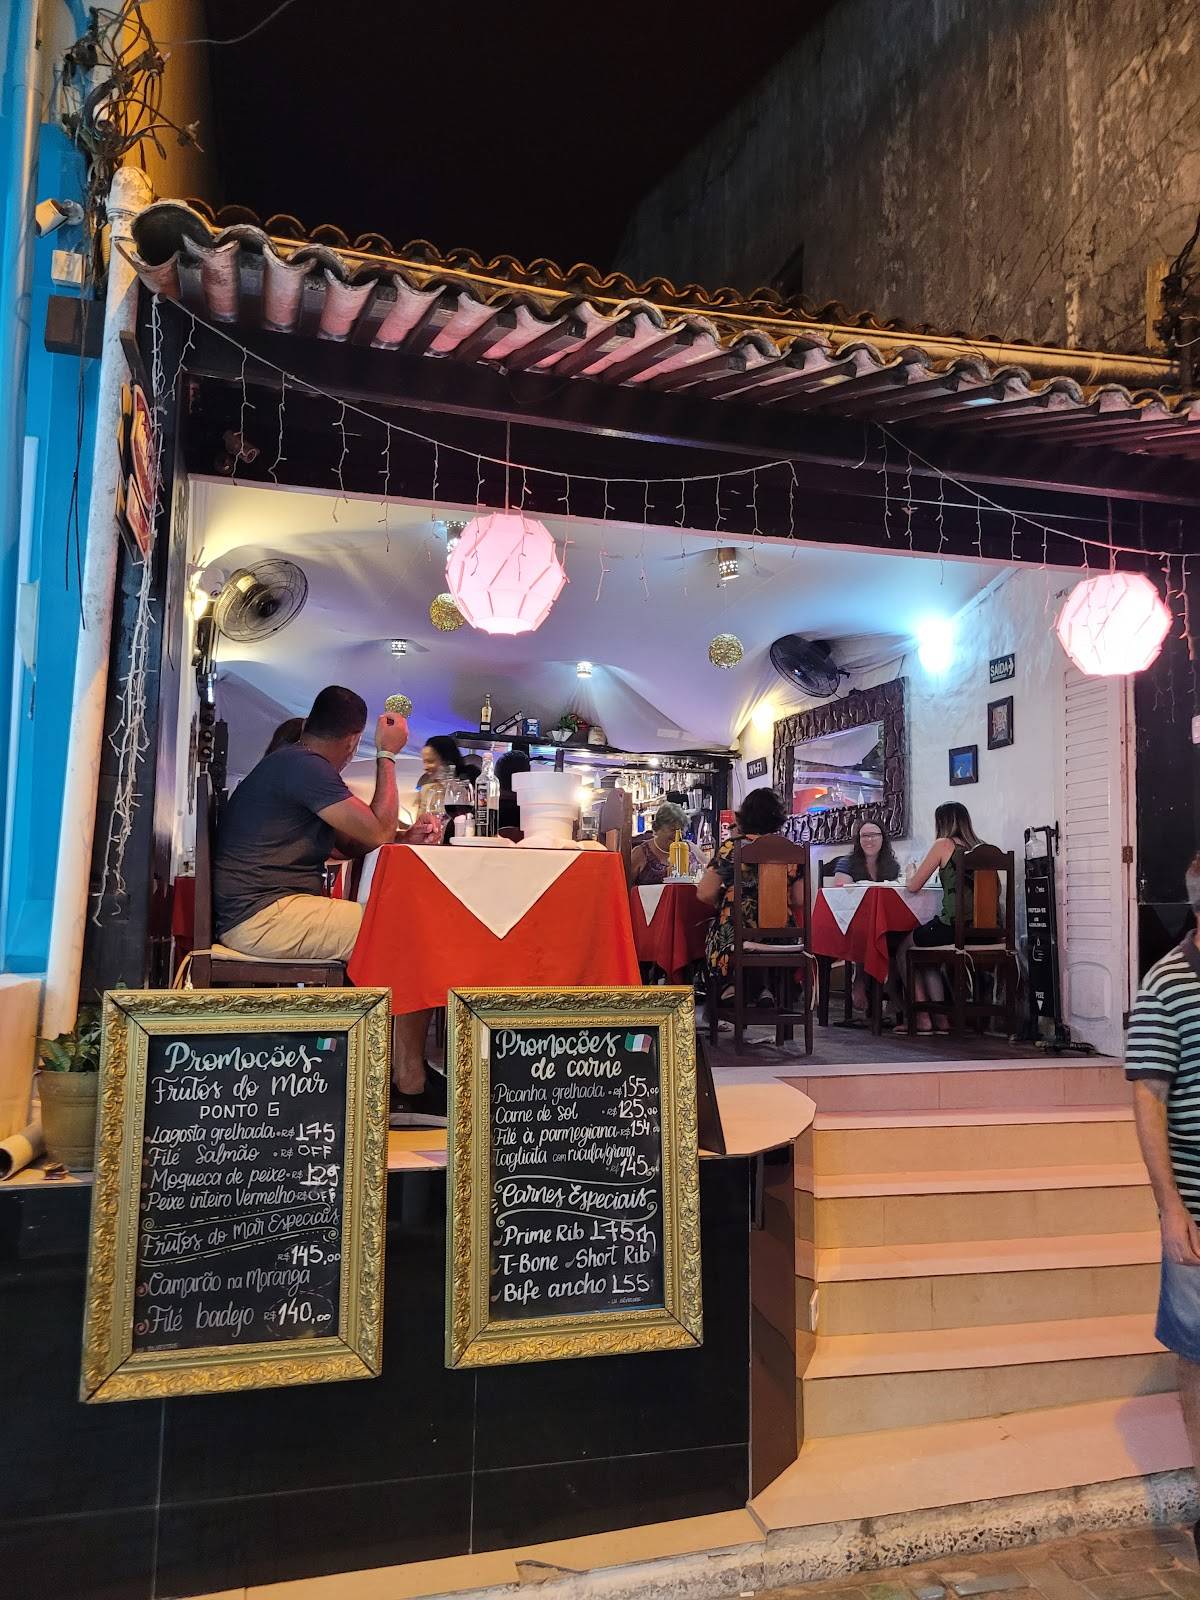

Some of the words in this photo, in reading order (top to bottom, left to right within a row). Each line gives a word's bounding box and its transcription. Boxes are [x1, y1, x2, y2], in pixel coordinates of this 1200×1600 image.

[990, 661, 1009, 677] SAÍDA
[164, 1041, 322, 1074] Promoções
[495, 1029, 621, 1059] Promoções
[530, 1057, 556, 1081] de
[566, 1057, 622, 1079] carne
[151, 1075, 223, 1105] Frutos
[232, 1074, 259, 1100] do
[493, 1083, 547, 1104] Picanha
[552, 1082, 605, 1105] grelhada
[200, 1103, 258, 1120] PONTO
[495, 1106, 533, 1124] Carne
[536, 1104, 551, 1122] de
[150, 1124, 207, 1149] Lagosta
[210, 1121, 276, 1147] grelhada
[494, 1127, 516, 1146] Filé
[522, 1127, 535, 1144] à
[539, 1123, 618, 1147] parmegiana
[149, 1146, 181, 1167] Filé
[195, 1143, 260, 1166] Salmão
[297, 1144, 333, 1160] OFF
[493, 1146, 547, 1173] Tagliata
[552, 1152, 567, 1162] com
[150, 1168, 222, 1192] Moqueca
[226, 1167, 244, 1185] de
[247, 1166, 287, 1189] peixe
[145, 1191, 185, 1211] Peixe
[189, 1189, 232, 1209] inteiro
[235, 1184, 295, 1206] Vermelho
[502, 1183, 566, 1208] Carnes
[568, 1183, 657, 1212] Especiais
[142, 1231, 204, 1257] Frutos
[208, 1227, 228, 1246] do
[267, 1208, 341, 1233] Especiais
[502, 1225, 552, 1247] Prime
[556, 1221, 584, 1242] Rib
[499, 1253, 559, 1276] T-Bone
[575, 1244, 620, 1269] Short
[624, 1244, 650, 1265] Rib
[148, 1271, 222, 1299] Camarão
[227, 1275, 243, 1290] na
[504, 1278, 542, 1305] Bife
[547, 1272, 607, 1298] ancho
[148, 1304, 183, 1334] Filé
[196, 1300, 254, 1338] badejo
